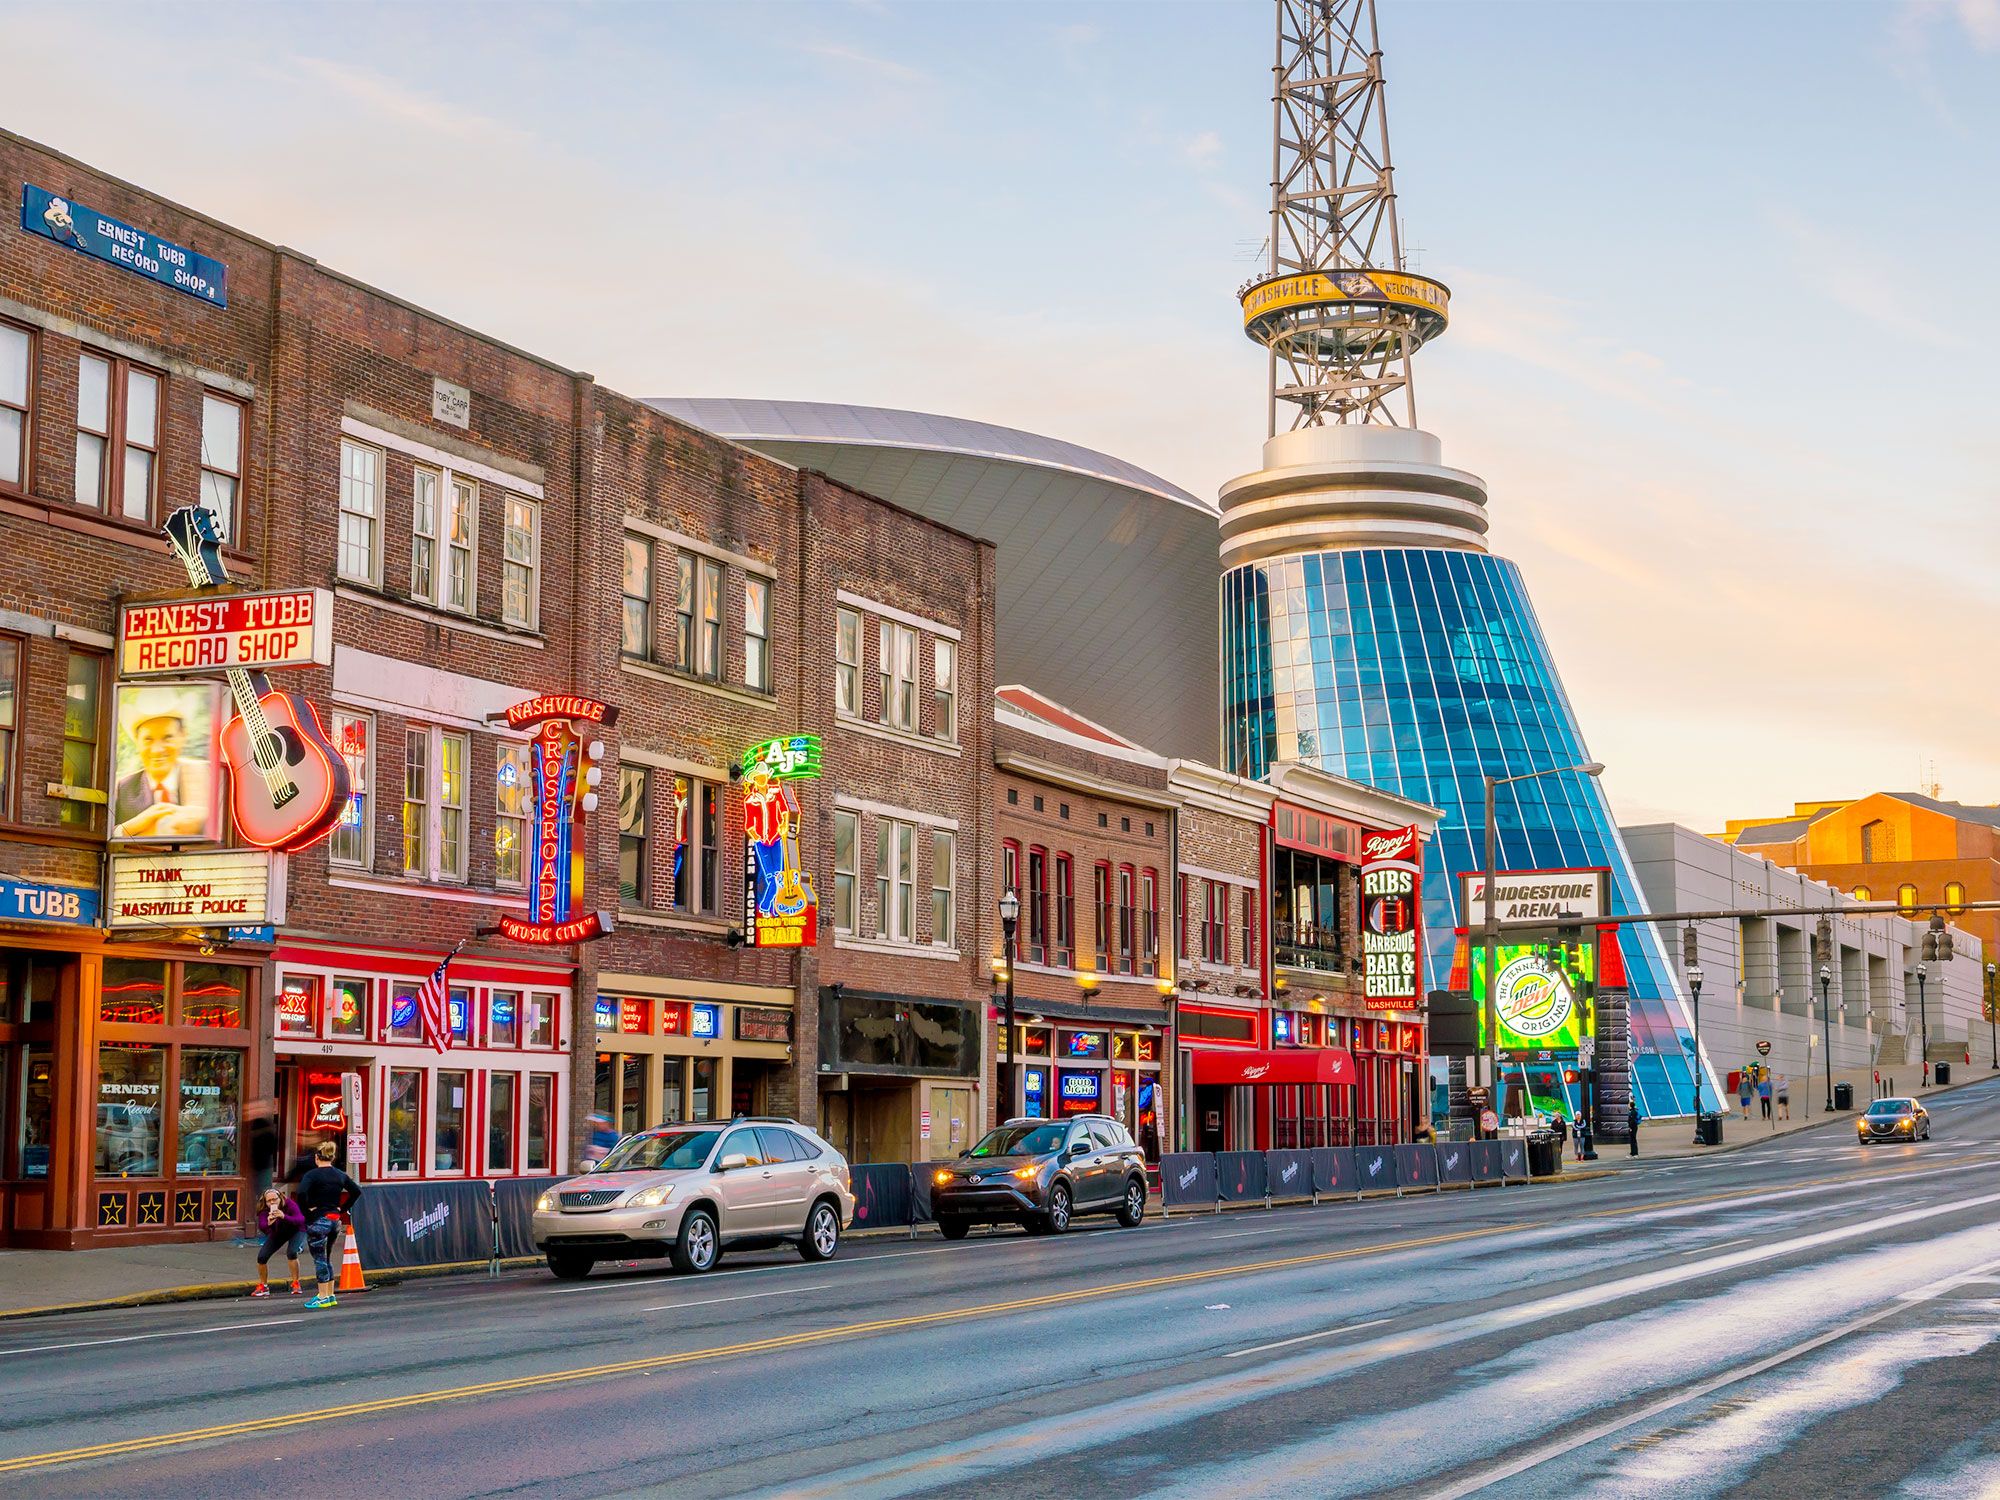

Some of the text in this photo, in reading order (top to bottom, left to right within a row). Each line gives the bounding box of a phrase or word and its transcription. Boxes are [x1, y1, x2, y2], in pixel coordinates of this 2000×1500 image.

[97, 219, 186, 268] ERNEST TUBB
[111, 243, 207, 292] RECORD SHOP
[1385, 282, 1418, 297] WELCOME
[127, 594, 313, 638] ERNEST TUBB
[138, 631, 299, 671] RECORD SHOP
[508, 696, 606, 723] NASHVILLE
[539, 721, 563, 921] CROSSROADS
[1362, 827, 1412, 856] Rippy's
[747, 838, 755, 875] ALAN
[138, 868, 182, 883] THANK
[1365, 870, 1413, 895] RIBS
[183, 883, 211, 898] YOU
[14, 888, 80, 918] TUBB
[121, 899, 247, 916] NASHVILLE POLICE
[746, 881, 755, 944] JACKSON
[1506, 902, 1561, 918] ARENA
[760, 927, 802, 944] BAR
[1364, 930, 1415, 953] BARBEQUE
[1366, 953, 1415, 975] BAR &
[1366, 975, 1415, 997] GRILL
[1500, 981, 1509, 1000] THE
[1367, 1000, 1414, 1009] NASHVILLE
[1521, 997, 1568, 1031] ORIGINAL
[321, 1045, 333, 1053] 419
[101, 1084, 221, 1096] ERNEST TUBB
[1064, 1086, 1096, 1095] LIGHT
[1068, 1078, 1092, 1086] BUD
[122, 1099, 206, 1118] Record Shop
[404, 1201, 450, 1243] Nashville
